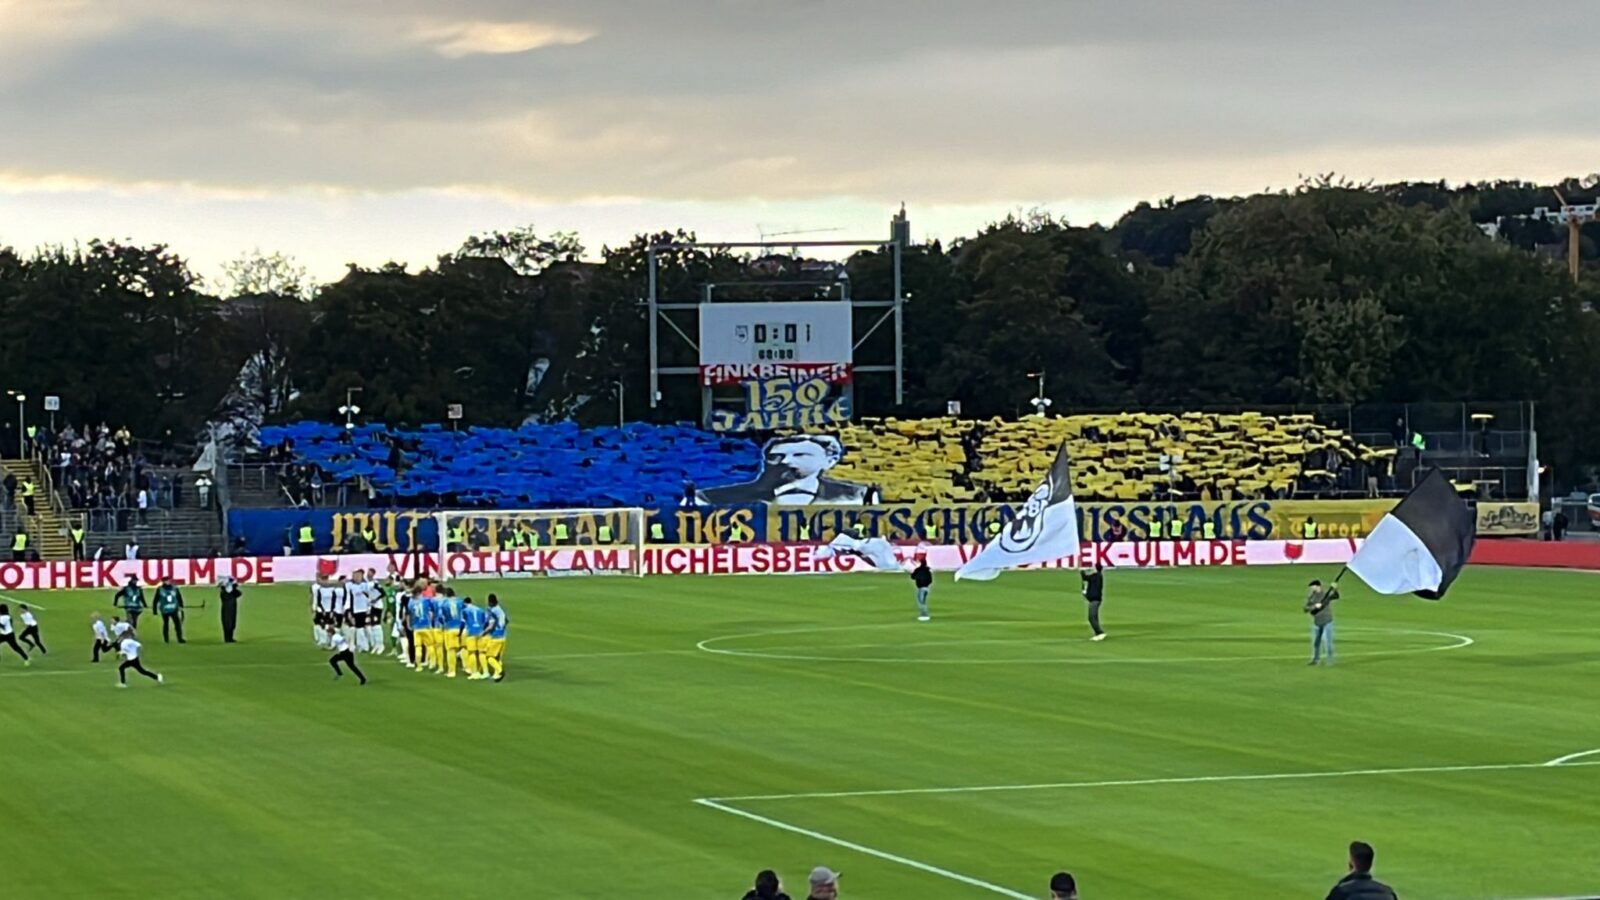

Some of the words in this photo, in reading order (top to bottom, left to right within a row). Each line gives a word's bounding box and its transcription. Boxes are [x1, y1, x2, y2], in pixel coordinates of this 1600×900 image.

[703, 363, 848, 386] FINKBEINER
[744, 377, 829, 412] 150
[675, 508, 756, 545] DES
[570, 548, 620, 571] AM
